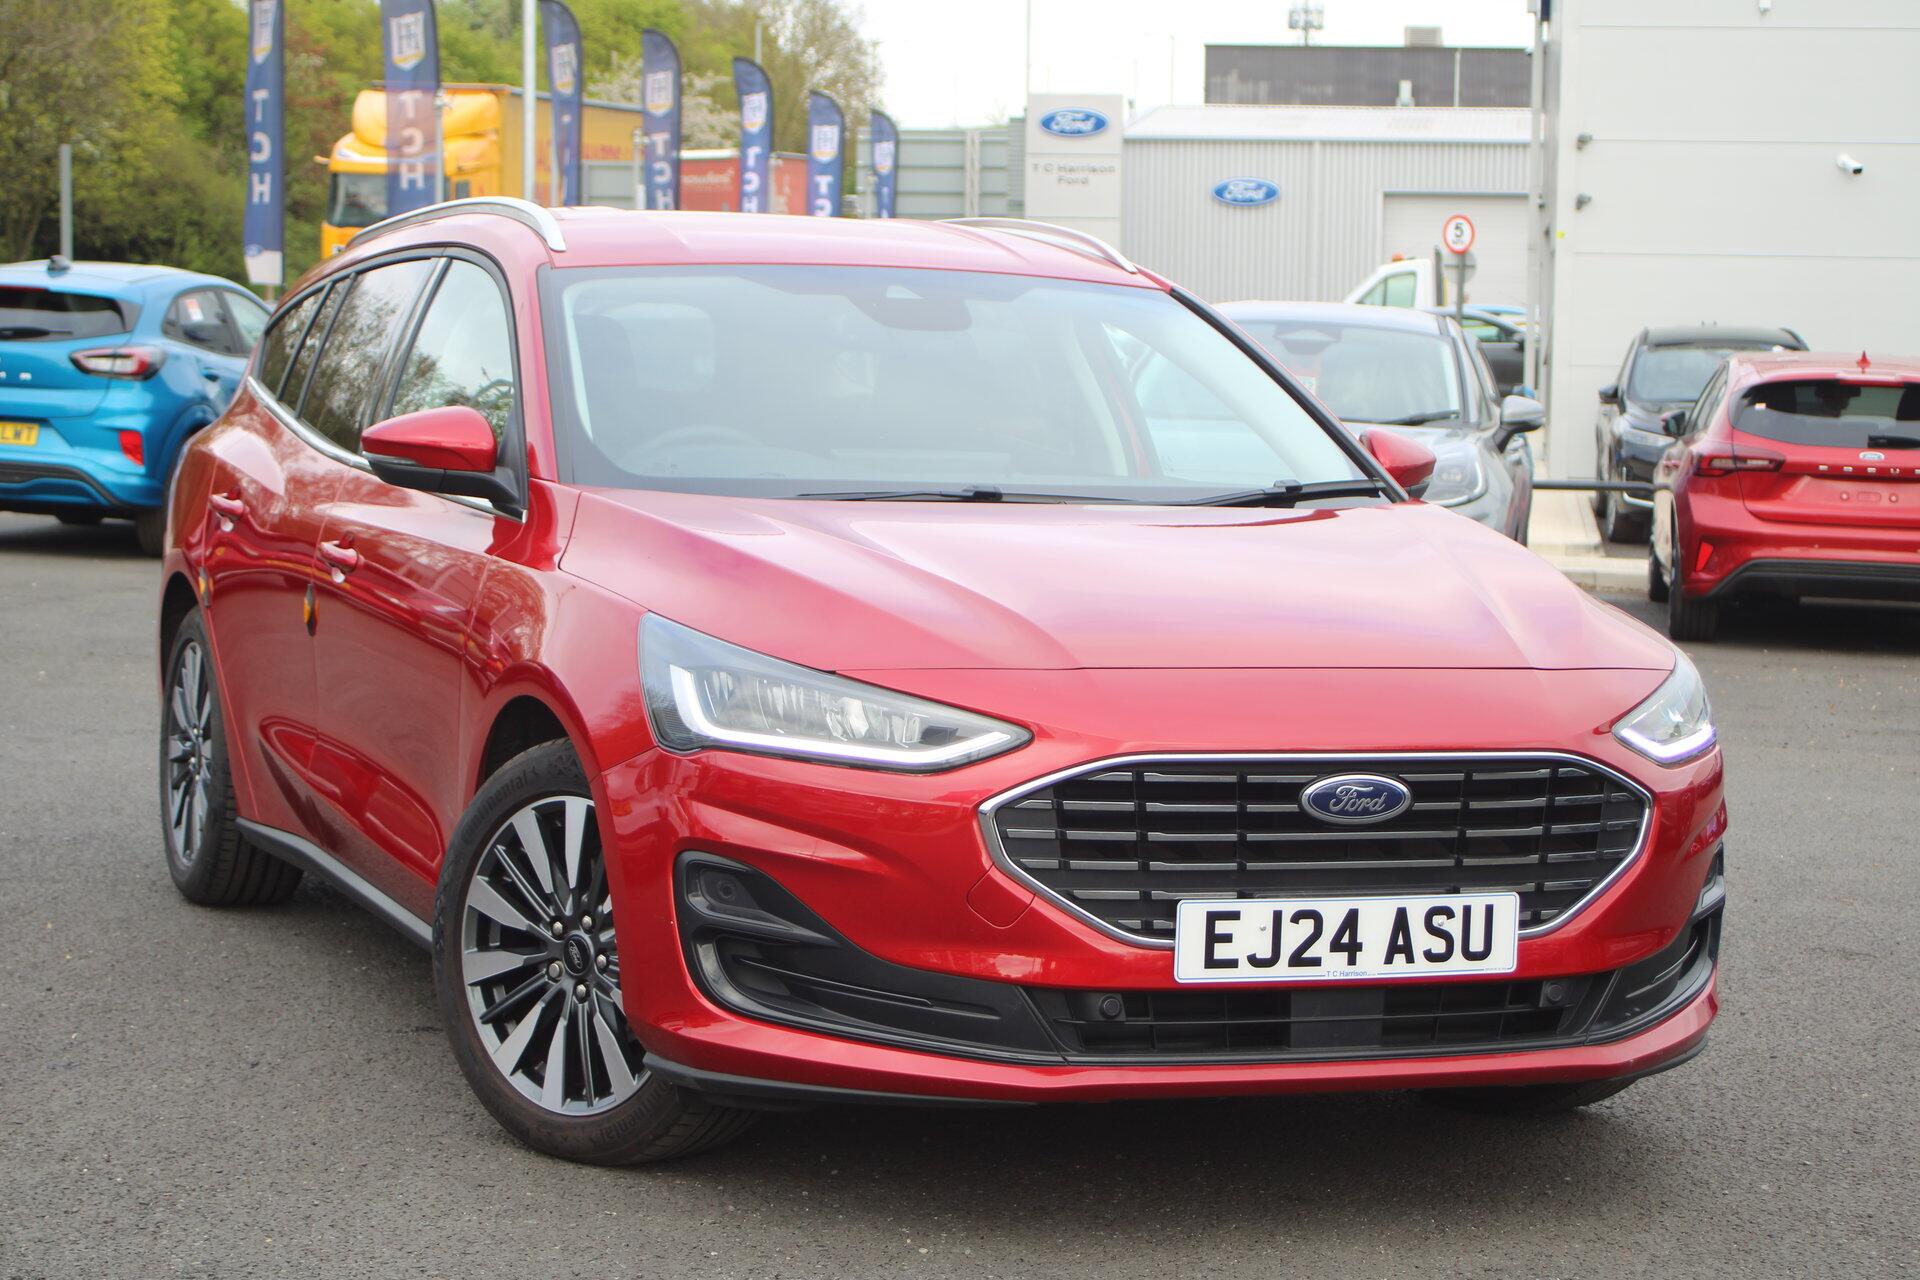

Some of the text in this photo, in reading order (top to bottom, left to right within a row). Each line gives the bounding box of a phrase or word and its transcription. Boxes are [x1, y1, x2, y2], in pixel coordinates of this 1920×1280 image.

[1454, 221, 1465, 238] 5
[1329, 785, 1388, 812] Ford
[1204, 904, 1494, 969] EJ24 ASU
